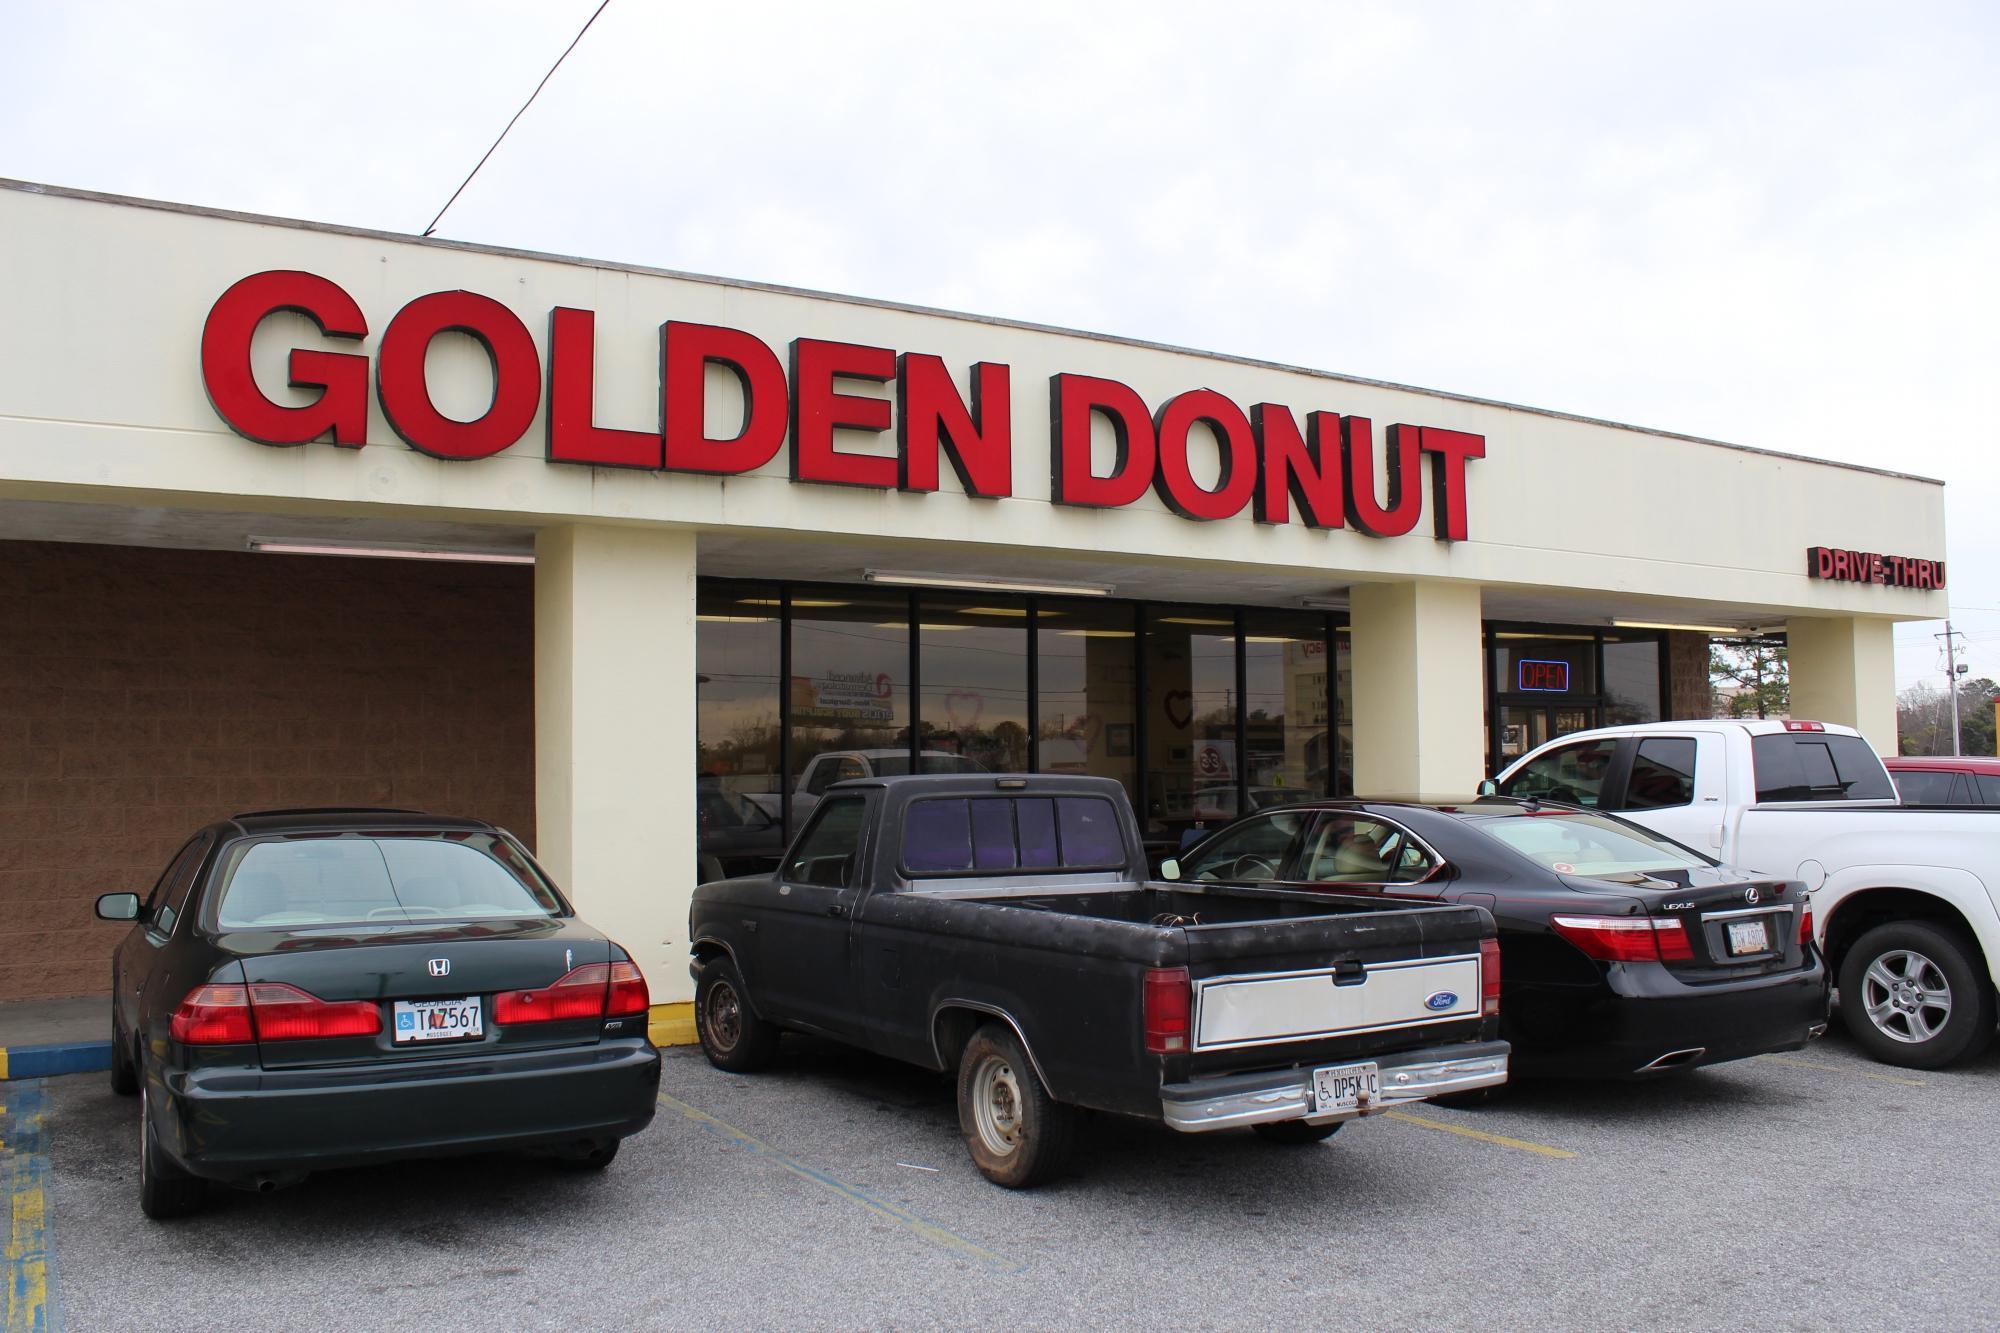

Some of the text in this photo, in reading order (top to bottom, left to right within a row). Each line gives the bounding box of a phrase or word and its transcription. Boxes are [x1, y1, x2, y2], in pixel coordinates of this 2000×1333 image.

[200, 269, 1487, 543] GOLDEN DONUT
[1807, 546, 1946, 590] DRIVE-THRU
[1522, 663, 1566, 689] OPEN
[1663, 902, 1695, 910] LEXUS
[417, 1006, 480, 1030] TAZ567
